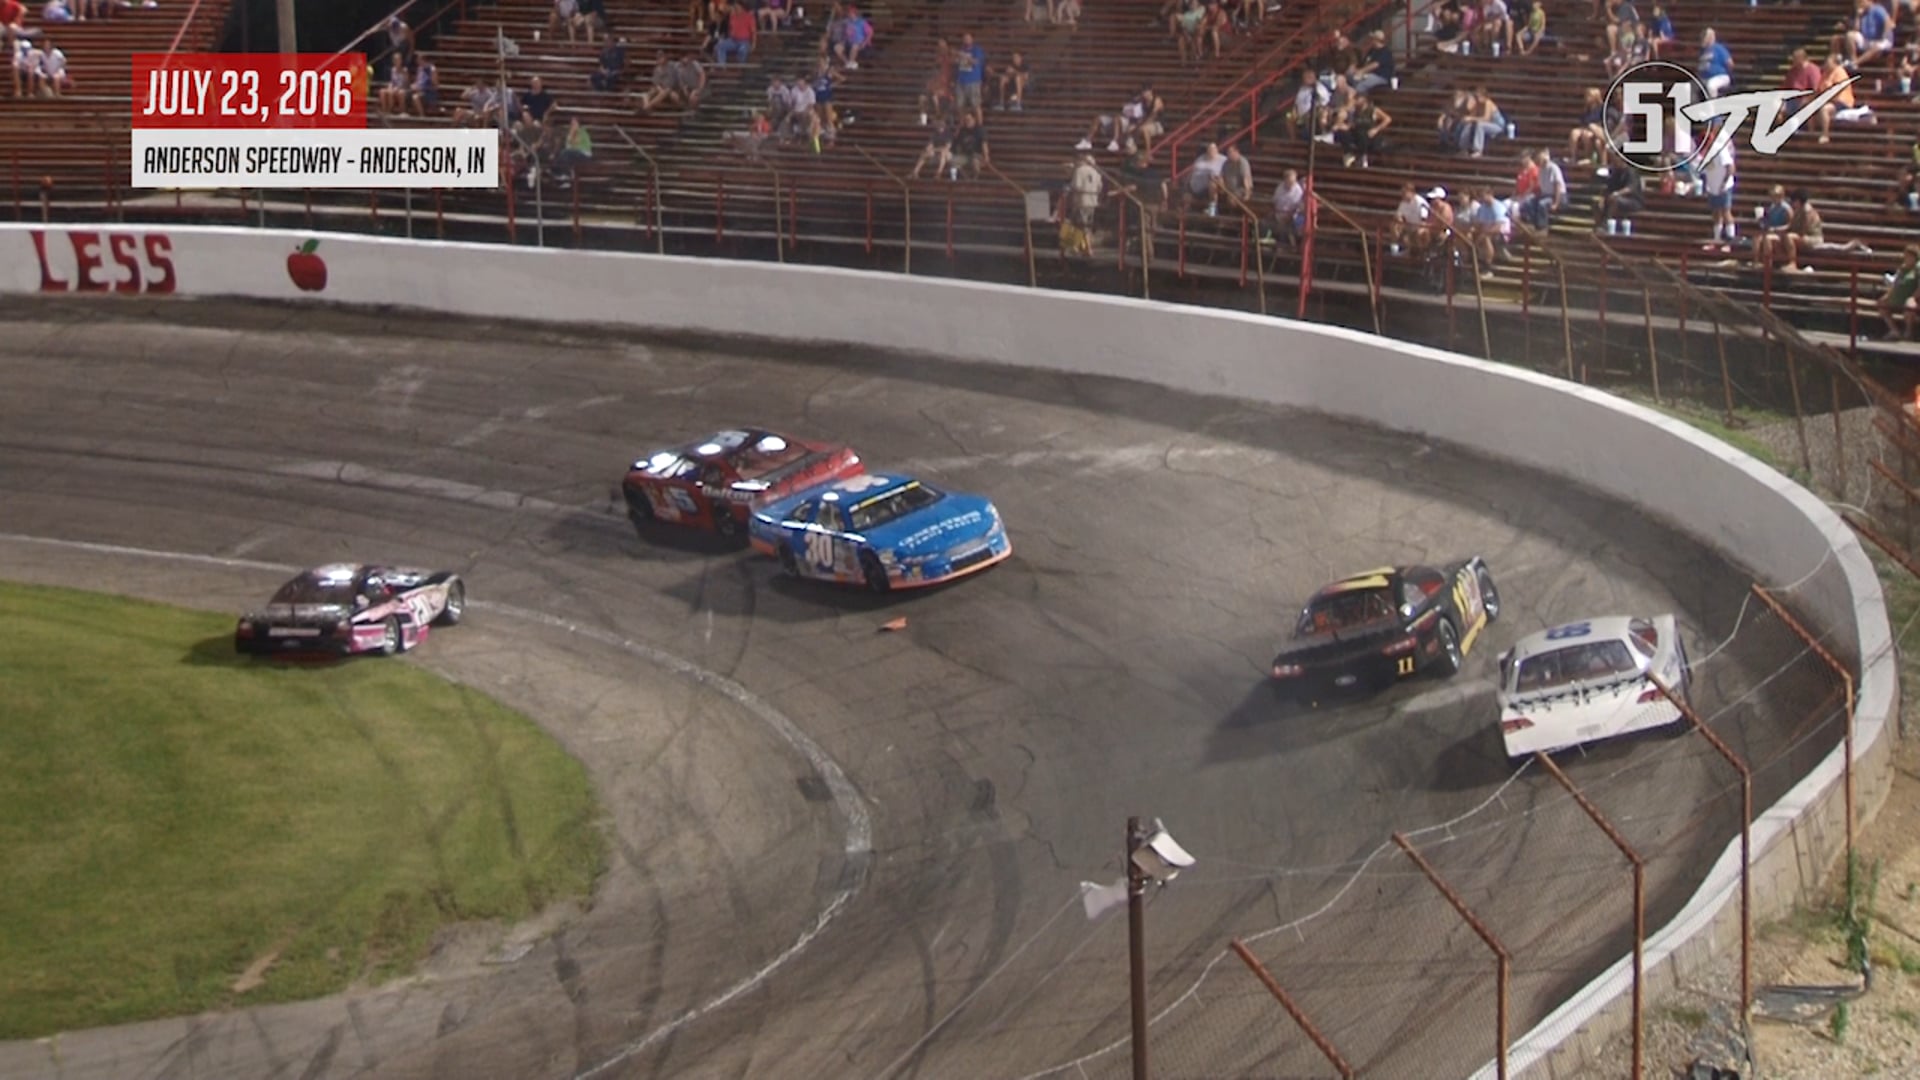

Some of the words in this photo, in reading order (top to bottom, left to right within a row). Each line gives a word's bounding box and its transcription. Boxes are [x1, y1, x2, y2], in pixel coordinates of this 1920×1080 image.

[29, 230, 176, 294] LESS
[804, 532, 833, 568] 30
[1397, 656, 1415, 675] 11
